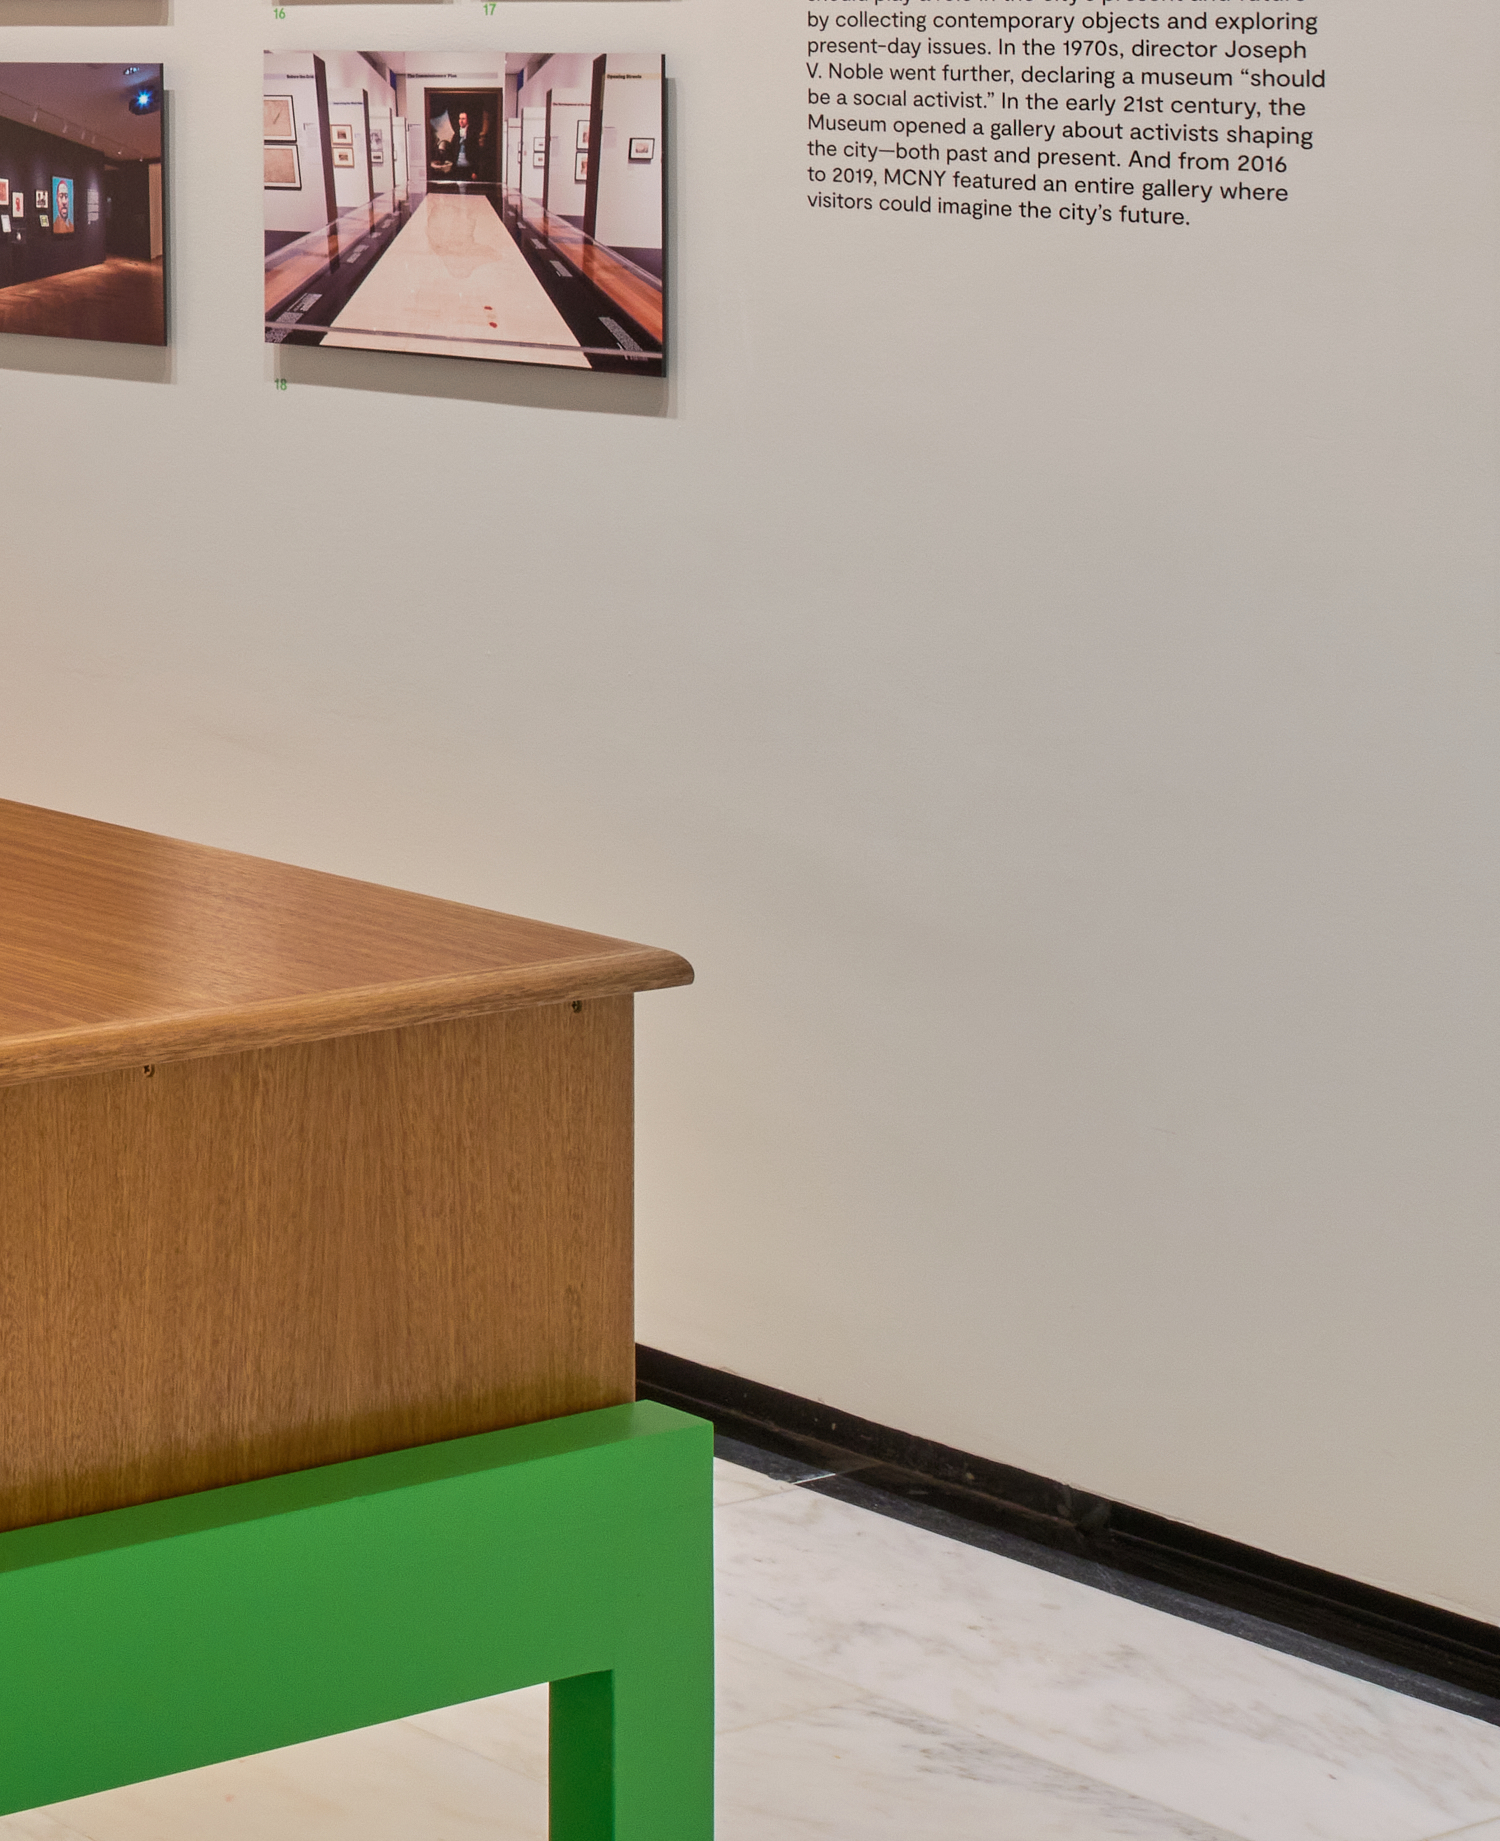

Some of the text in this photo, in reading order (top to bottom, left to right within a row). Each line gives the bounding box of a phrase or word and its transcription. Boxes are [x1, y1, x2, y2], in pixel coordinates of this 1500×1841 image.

[274, 8, 286, 19] 16
[484, 2, 496, 15] 17
[276, 379, 287, 390] 18
